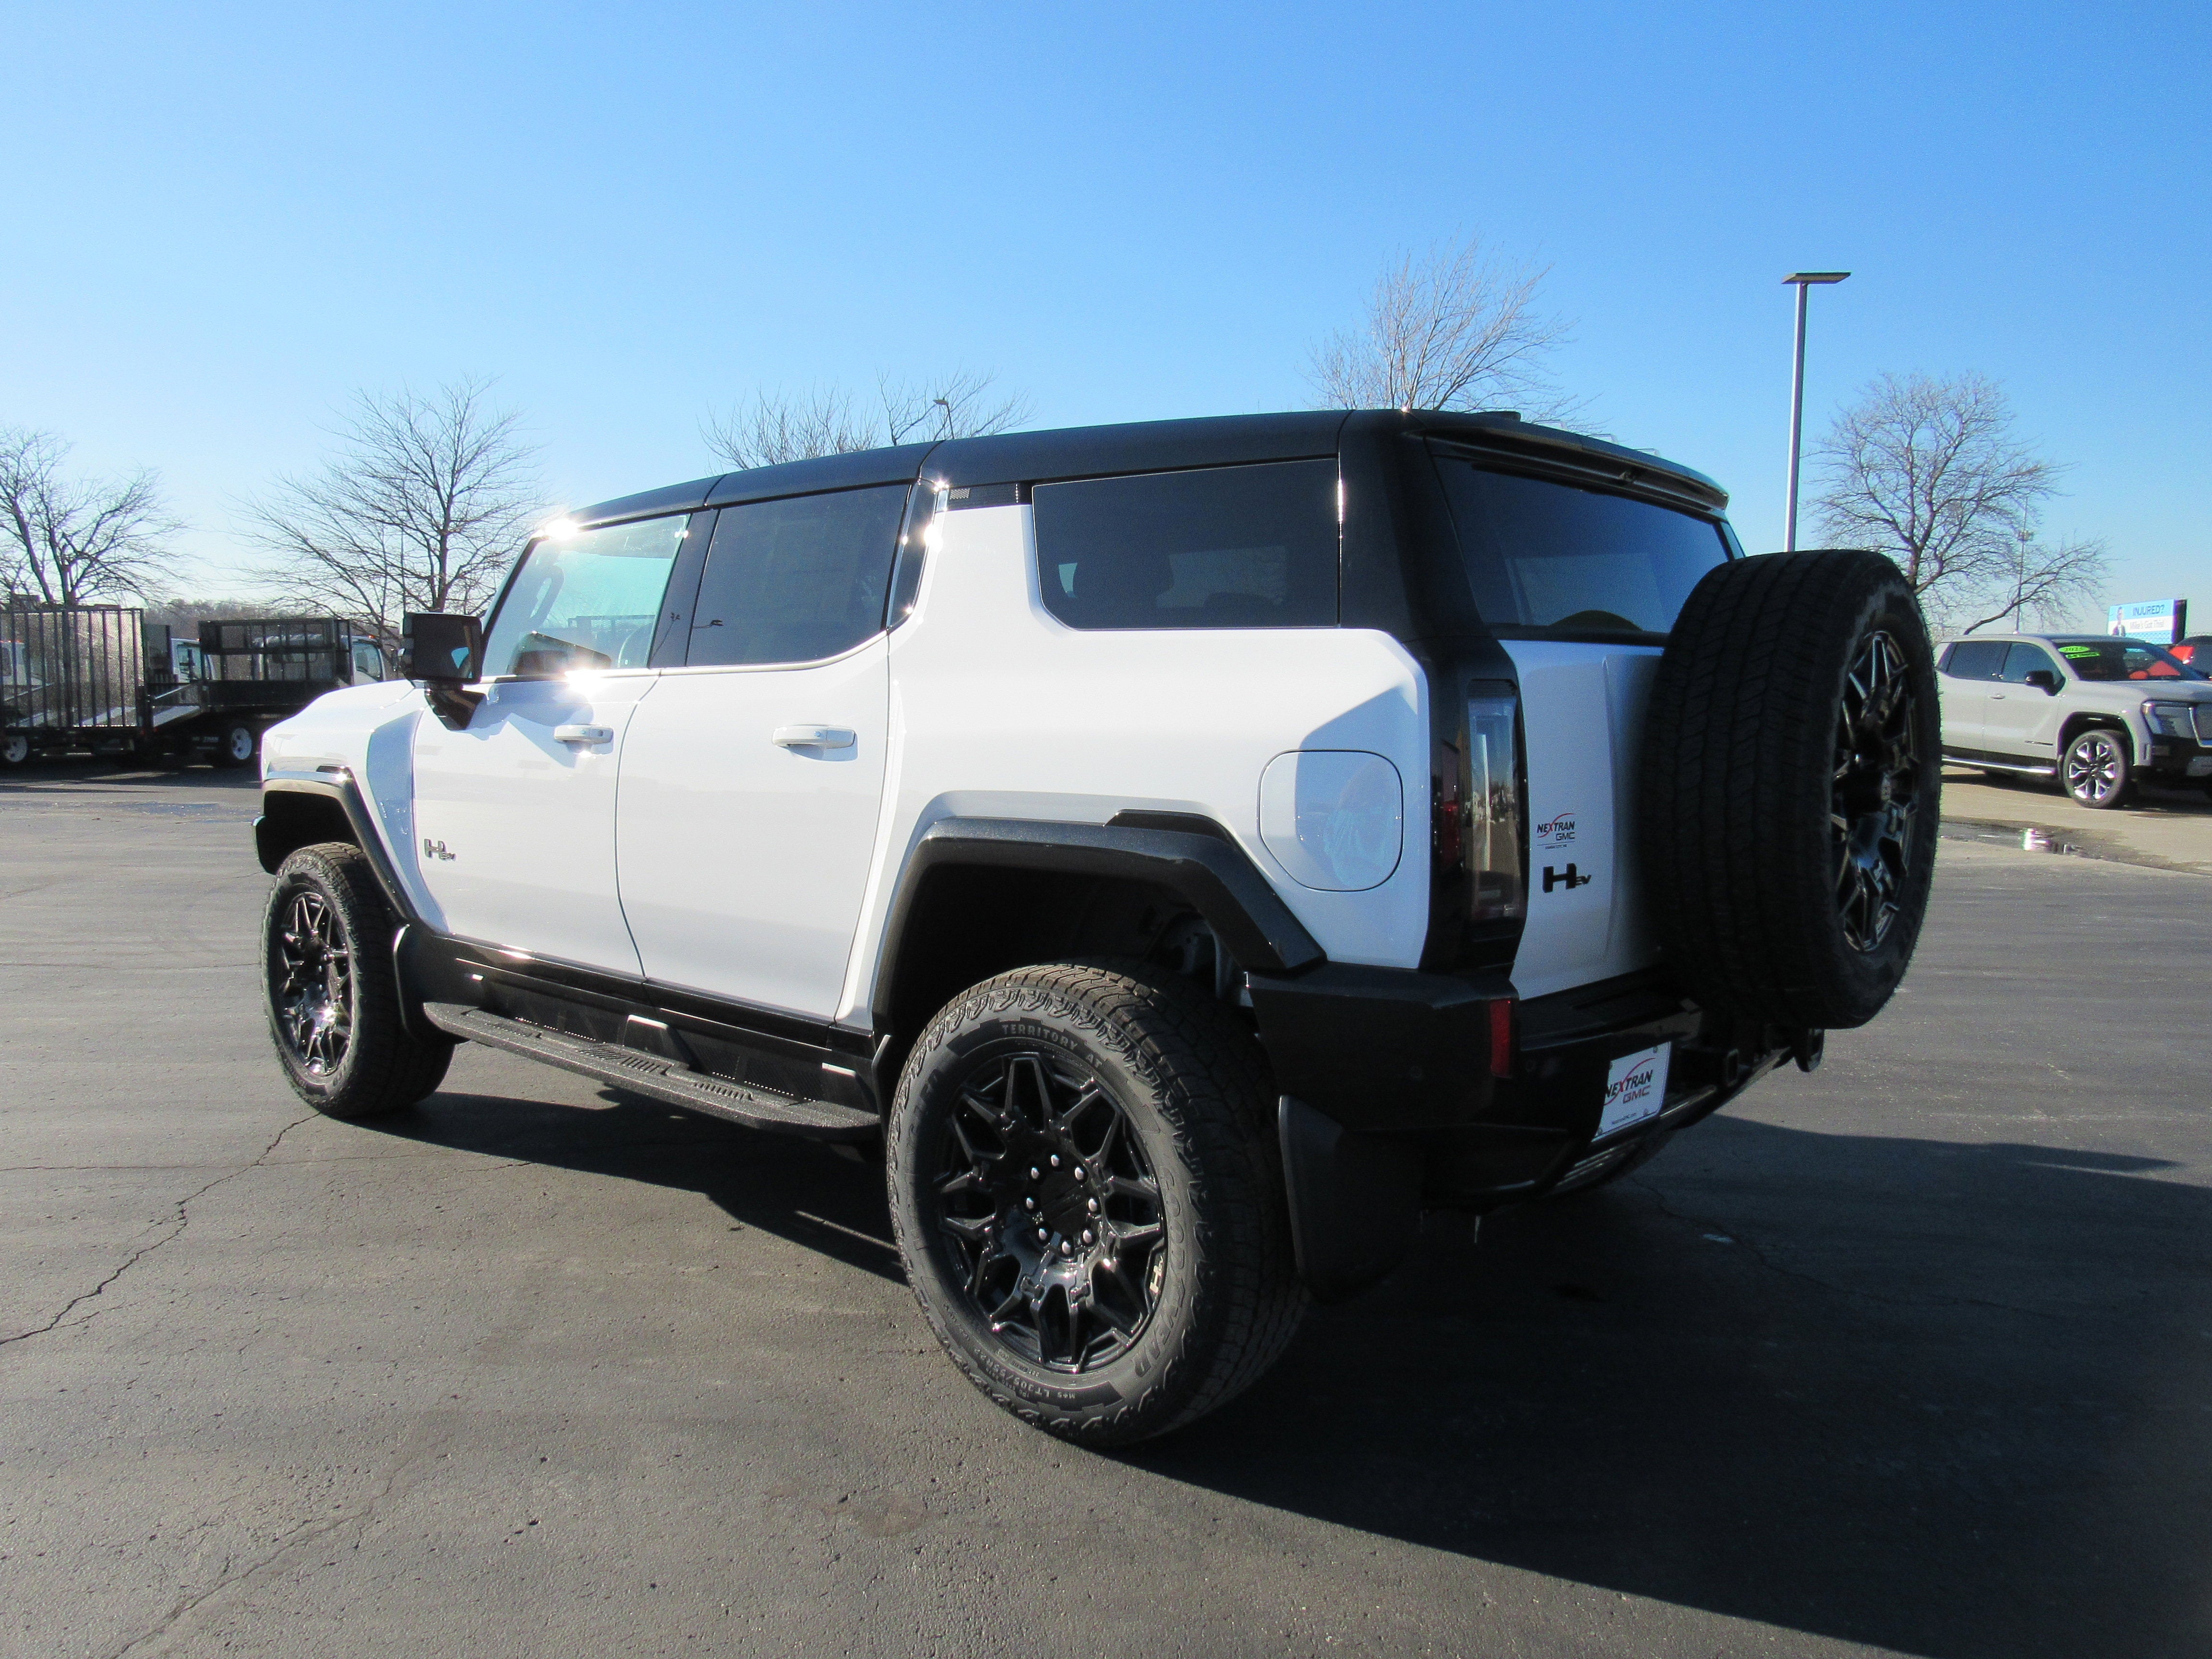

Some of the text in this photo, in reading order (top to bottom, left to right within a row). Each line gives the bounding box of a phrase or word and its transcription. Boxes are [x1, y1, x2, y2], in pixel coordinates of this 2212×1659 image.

[2132, 604, 2165, 616] INJURED?
[1537, 820, 1575, 834] NEXTRAN
[1555, 831, 1575, 841] GMC
[1002, 1023, 1103, 1068] TERRITORY AT
[1623, 1085, 1651, 1104] GMC
